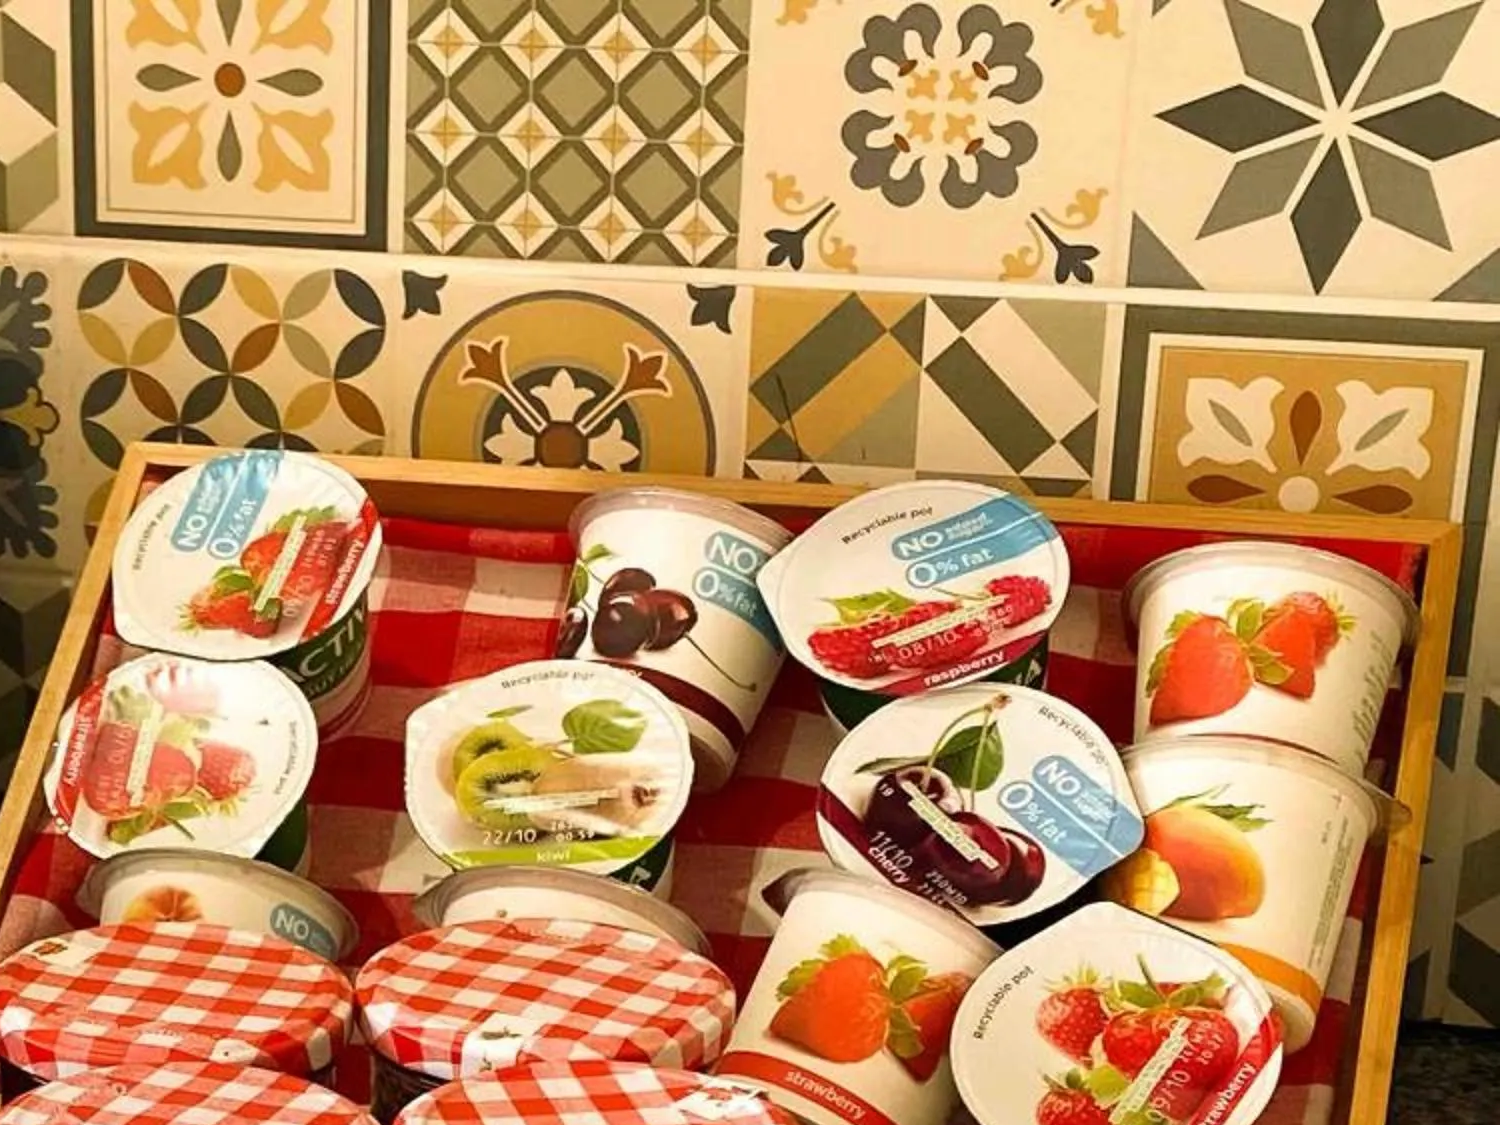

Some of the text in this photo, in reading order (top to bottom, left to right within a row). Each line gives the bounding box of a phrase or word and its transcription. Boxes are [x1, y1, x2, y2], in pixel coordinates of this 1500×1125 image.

[178, 514, 208, 548] NO
[841, 511, 907, 545] Recyclable
[898, 530, 944, 557] NO
[708, 535, 758, 575] NO
[960, 548, 995, 569] fat
[924, 650, 1006, 688] raspberry
[1040, 761, 1082, 798] NO
[482, 829, 537, 846] 22/10
[1039, 816, 1069, 845] fat
[536, 849, 571, 863] kiwi
[867, 846, 911, 885] cherry
[274, 908, 310, 941] NO
[972, 982, 1013, 1041] Recyclable
[784, 1070, 867, 1120] strawberry
